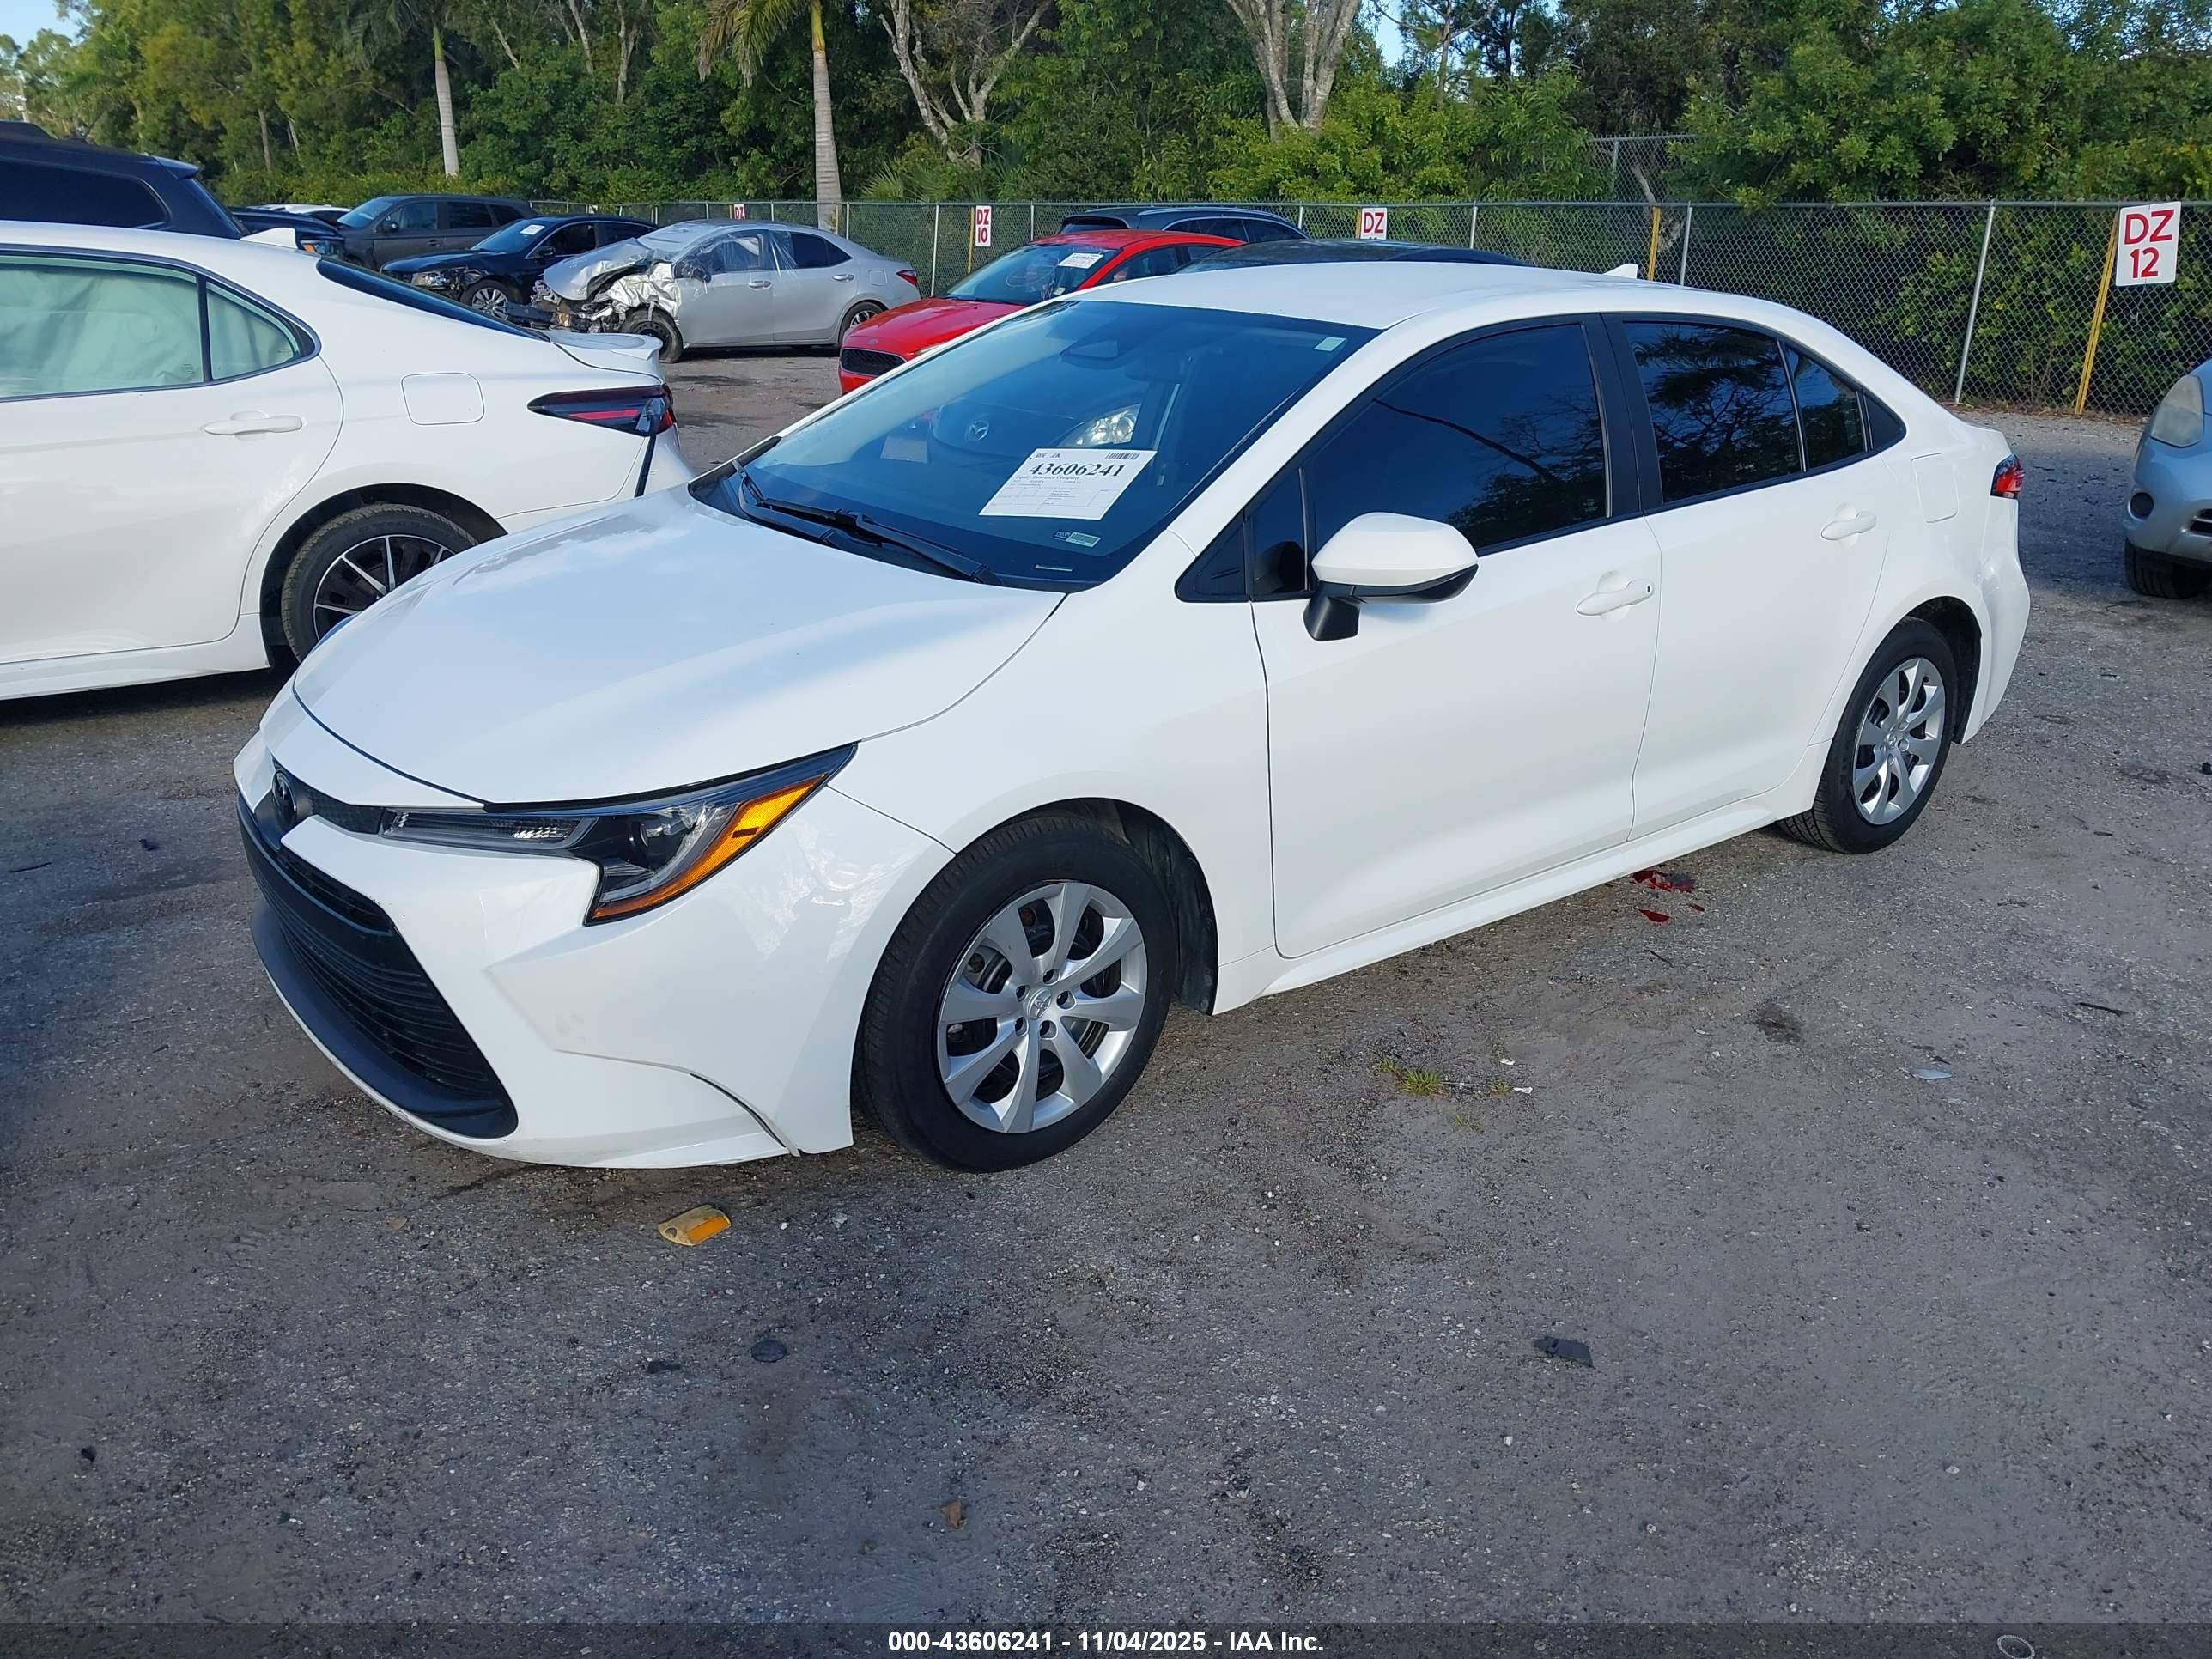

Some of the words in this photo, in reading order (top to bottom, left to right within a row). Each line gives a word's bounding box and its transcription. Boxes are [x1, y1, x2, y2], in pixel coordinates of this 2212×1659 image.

[976, 209, 990, 225] DZ
[1363, 212, 1385, 234] DZ
[977, 227, 988, 244] 10
[2124, 209, 2175, 245] DZ
[2130, 246, 2160, 279] 12
[1029, 463, 1125, 477] 43606241
